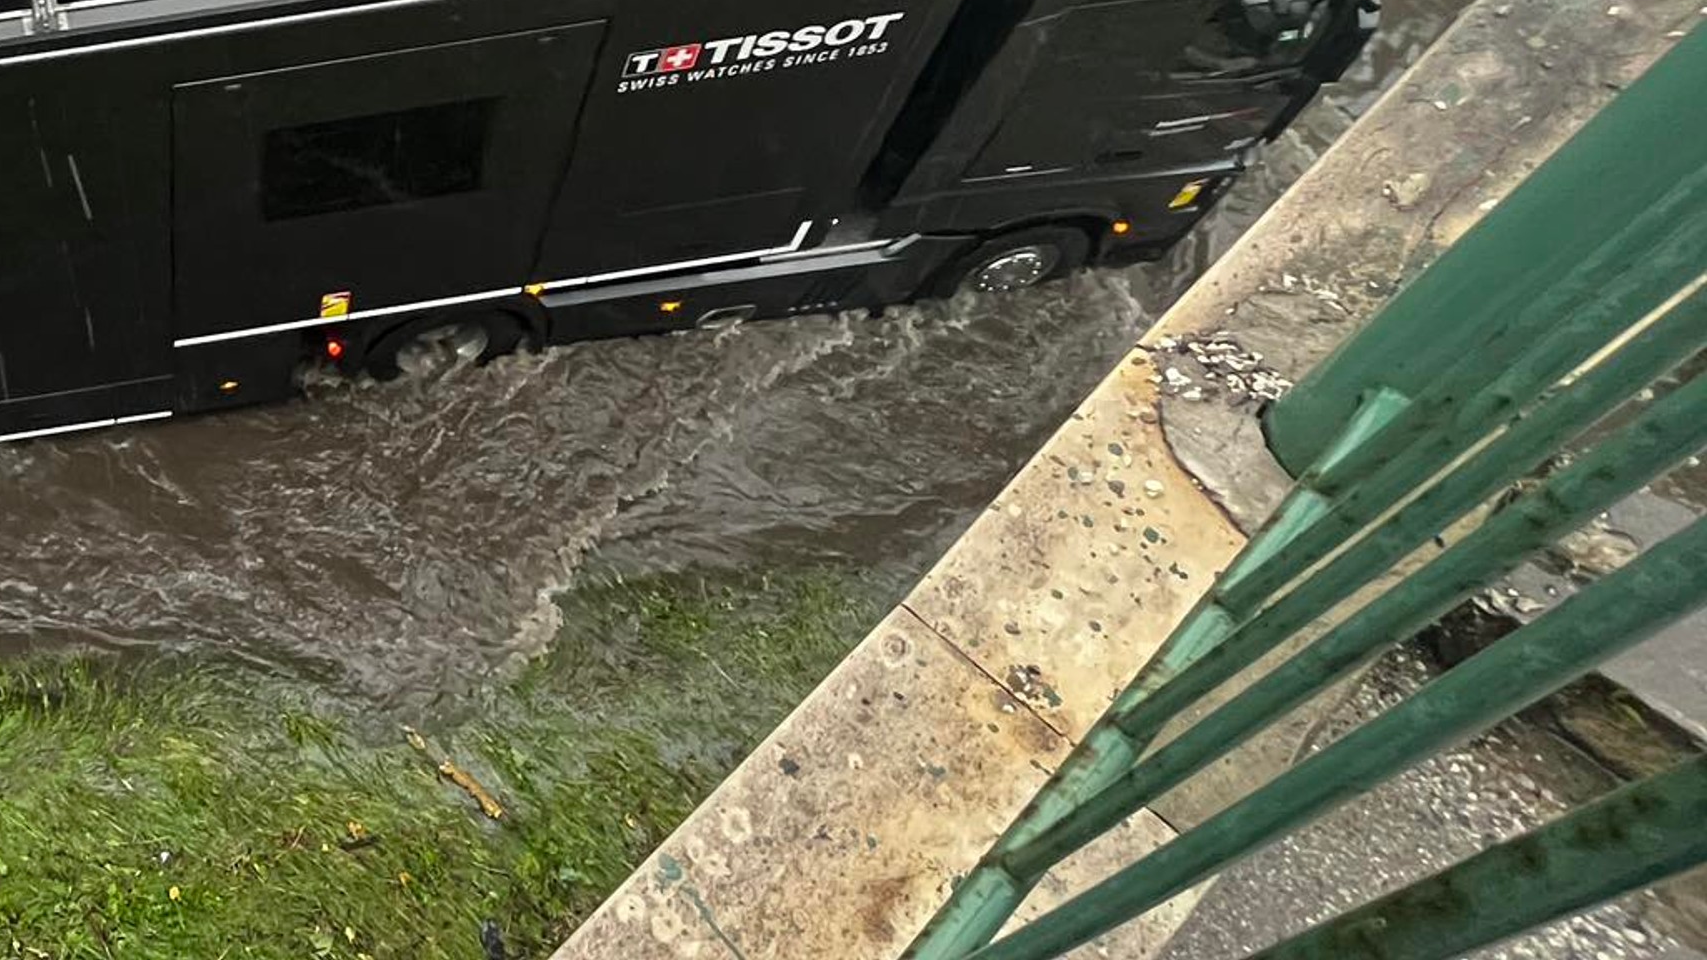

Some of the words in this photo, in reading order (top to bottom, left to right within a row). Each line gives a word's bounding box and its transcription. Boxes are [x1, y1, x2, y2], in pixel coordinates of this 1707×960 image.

[704, 12, 906, 65] TISSOT
[617, 73, 680, 94] SWISS
[687, 59, 776, 83] WATCHES
[782, 49, 840, 69] SINCE
[847, 41, 889, 59] 1853
